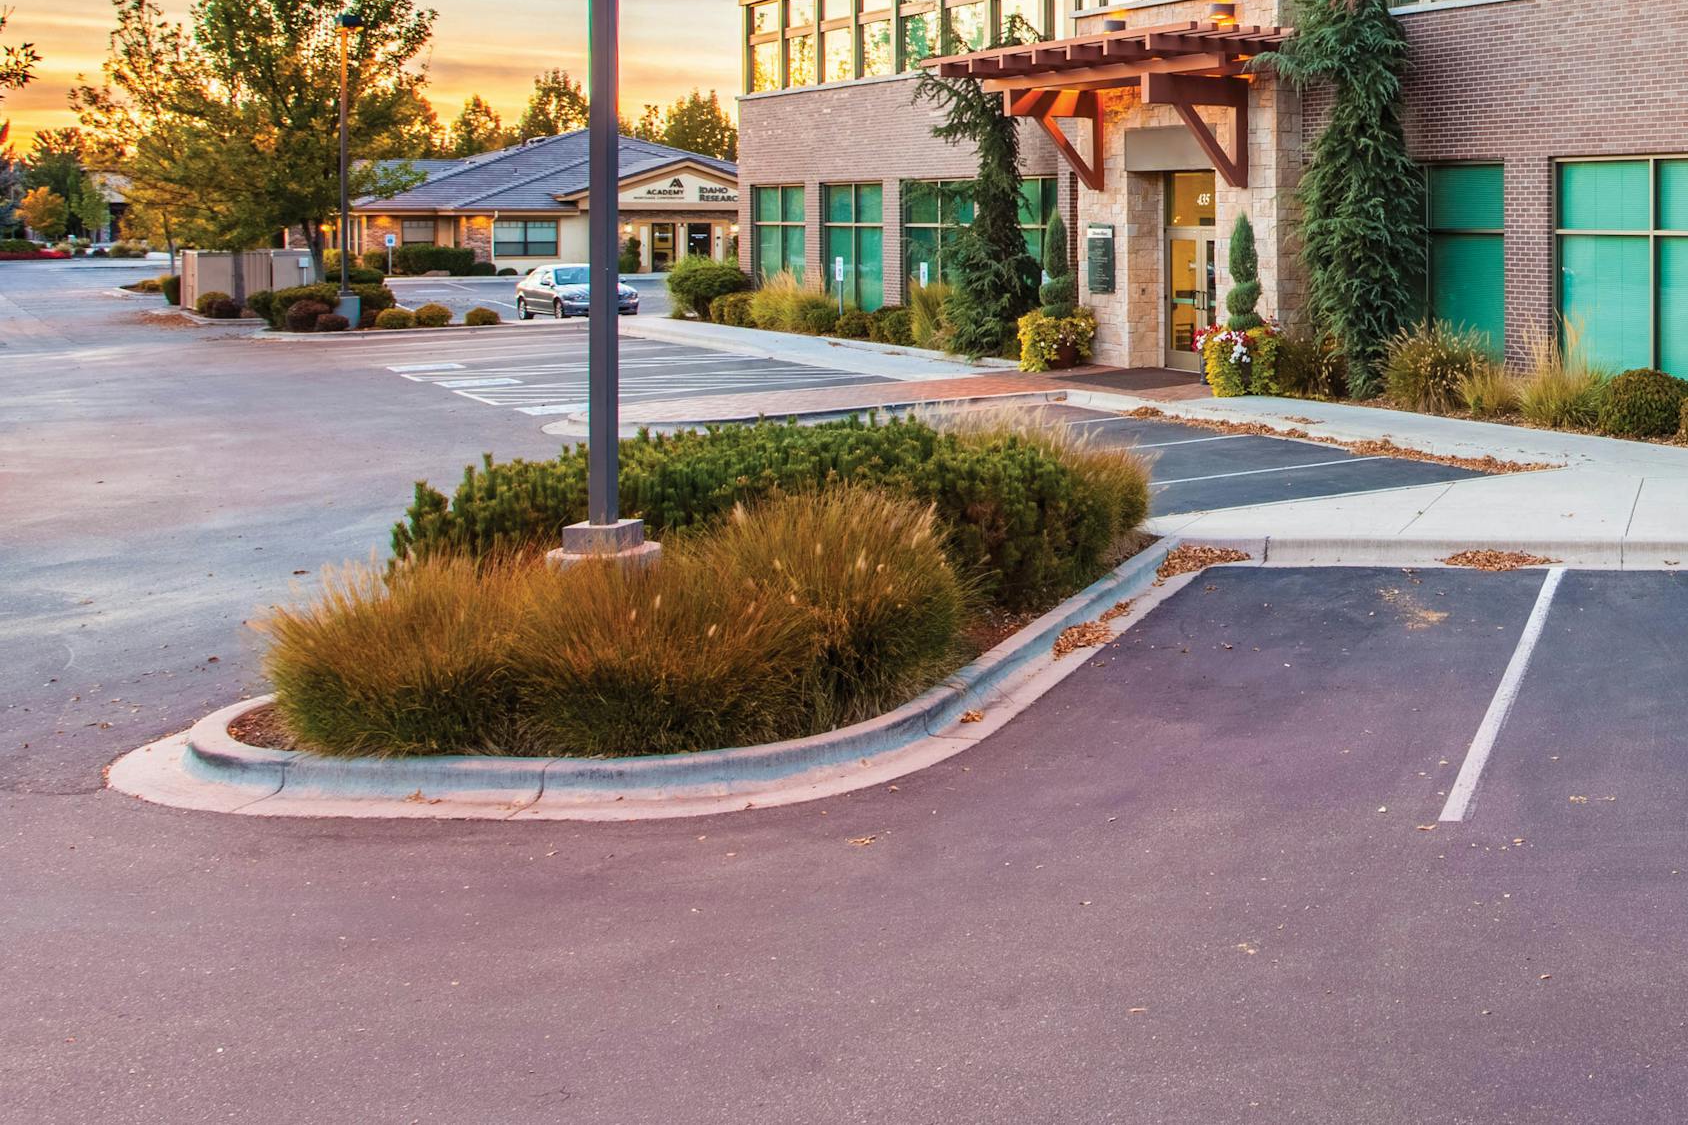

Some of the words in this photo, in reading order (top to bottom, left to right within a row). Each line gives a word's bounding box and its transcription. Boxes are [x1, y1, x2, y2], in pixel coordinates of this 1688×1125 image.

[699, 186, 728, 194] IDAHO
[699, 194, 738, 202] RESEARC
[1197, 193, 1210, 206] 435
